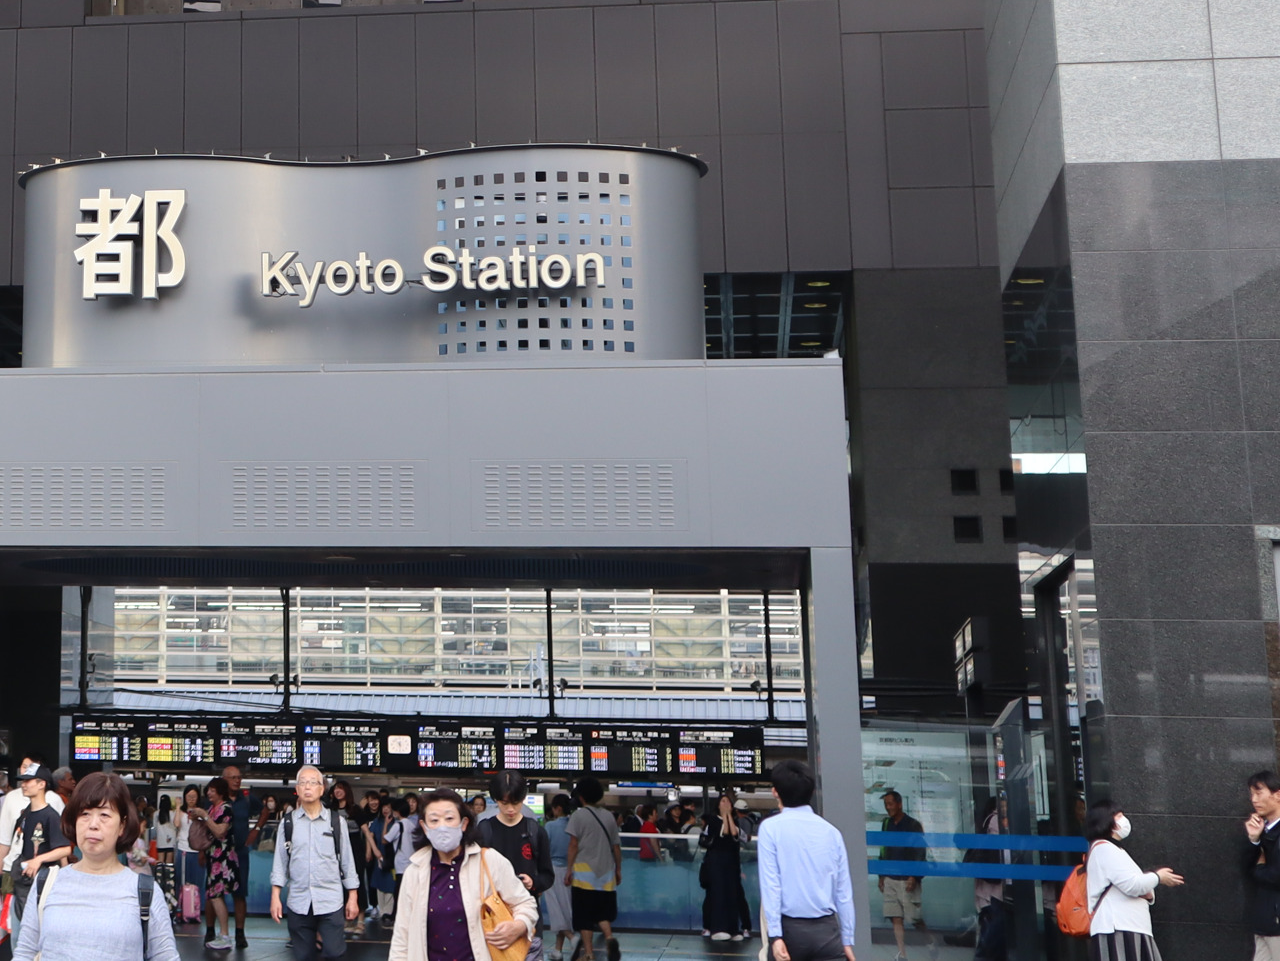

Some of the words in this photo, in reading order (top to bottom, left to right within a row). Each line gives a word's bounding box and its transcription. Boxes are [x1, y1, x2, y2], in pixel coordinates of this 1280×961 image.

[74, 188, 187, 302] 都
[259, 250, 404, 309] Kyoto
[421, 244, 606, 294] Station
